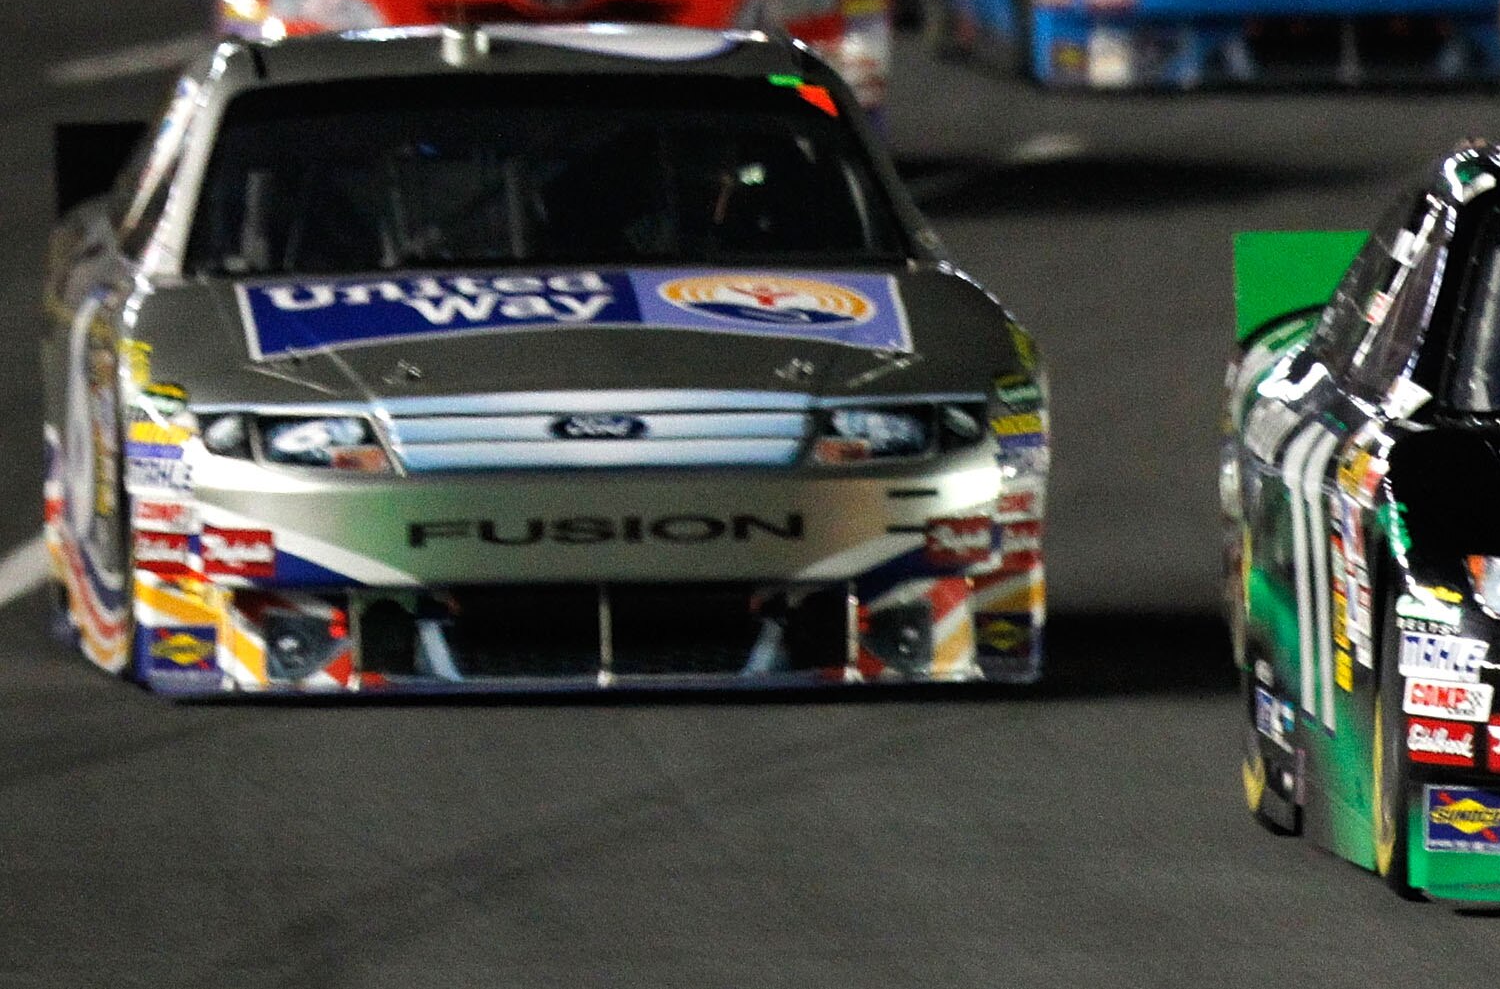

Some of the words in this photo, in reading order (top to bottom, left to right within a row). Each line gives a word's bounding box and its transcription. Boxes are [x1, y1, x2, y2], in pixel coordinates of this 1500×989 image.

[266, 272, 612, 311] United
[403, 289, 614, 325] Way
[405, 513, 805, 548] FUSION
